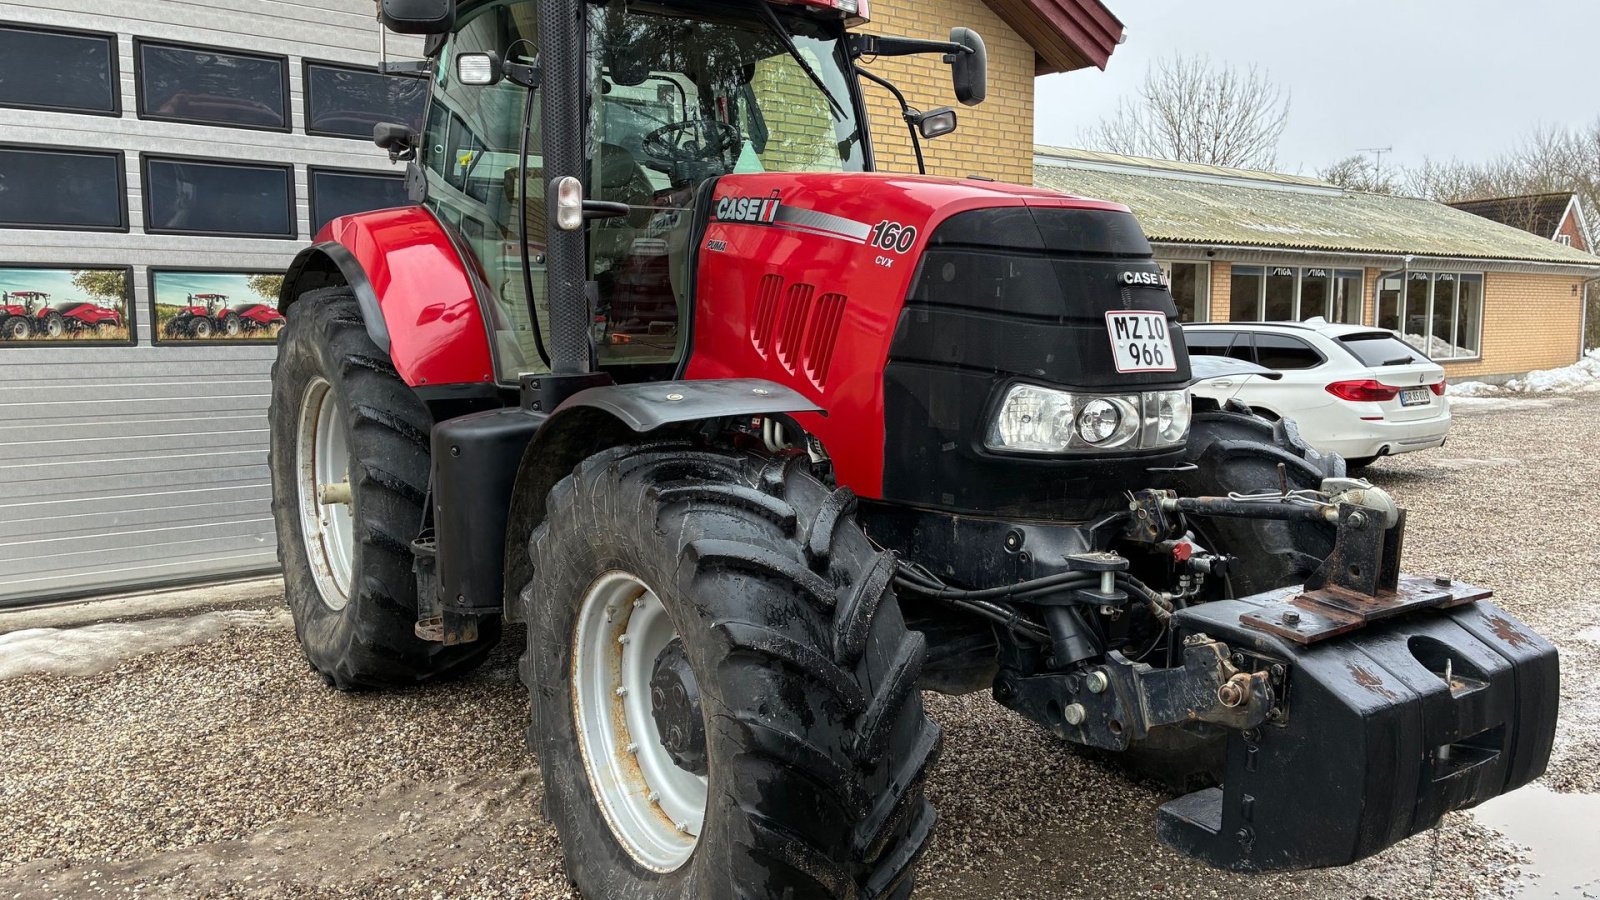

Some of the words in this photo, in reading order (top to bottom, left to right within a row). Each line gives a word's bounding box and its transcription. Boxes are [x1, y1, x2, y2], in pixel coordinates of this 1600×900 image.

[717, 196, 761, 221] CASE
[872, 220, 917, 254] 160
[705, 239, 728, 252] PUMA
[875, 255, 894, 268] CVX
[1123, 271, 1158, 285] CASE
[1273, 267, 1292, 276] STIGA
[1307, 269, 1326, 277] STIGA
[1128, 342, 1164, 366] 966
